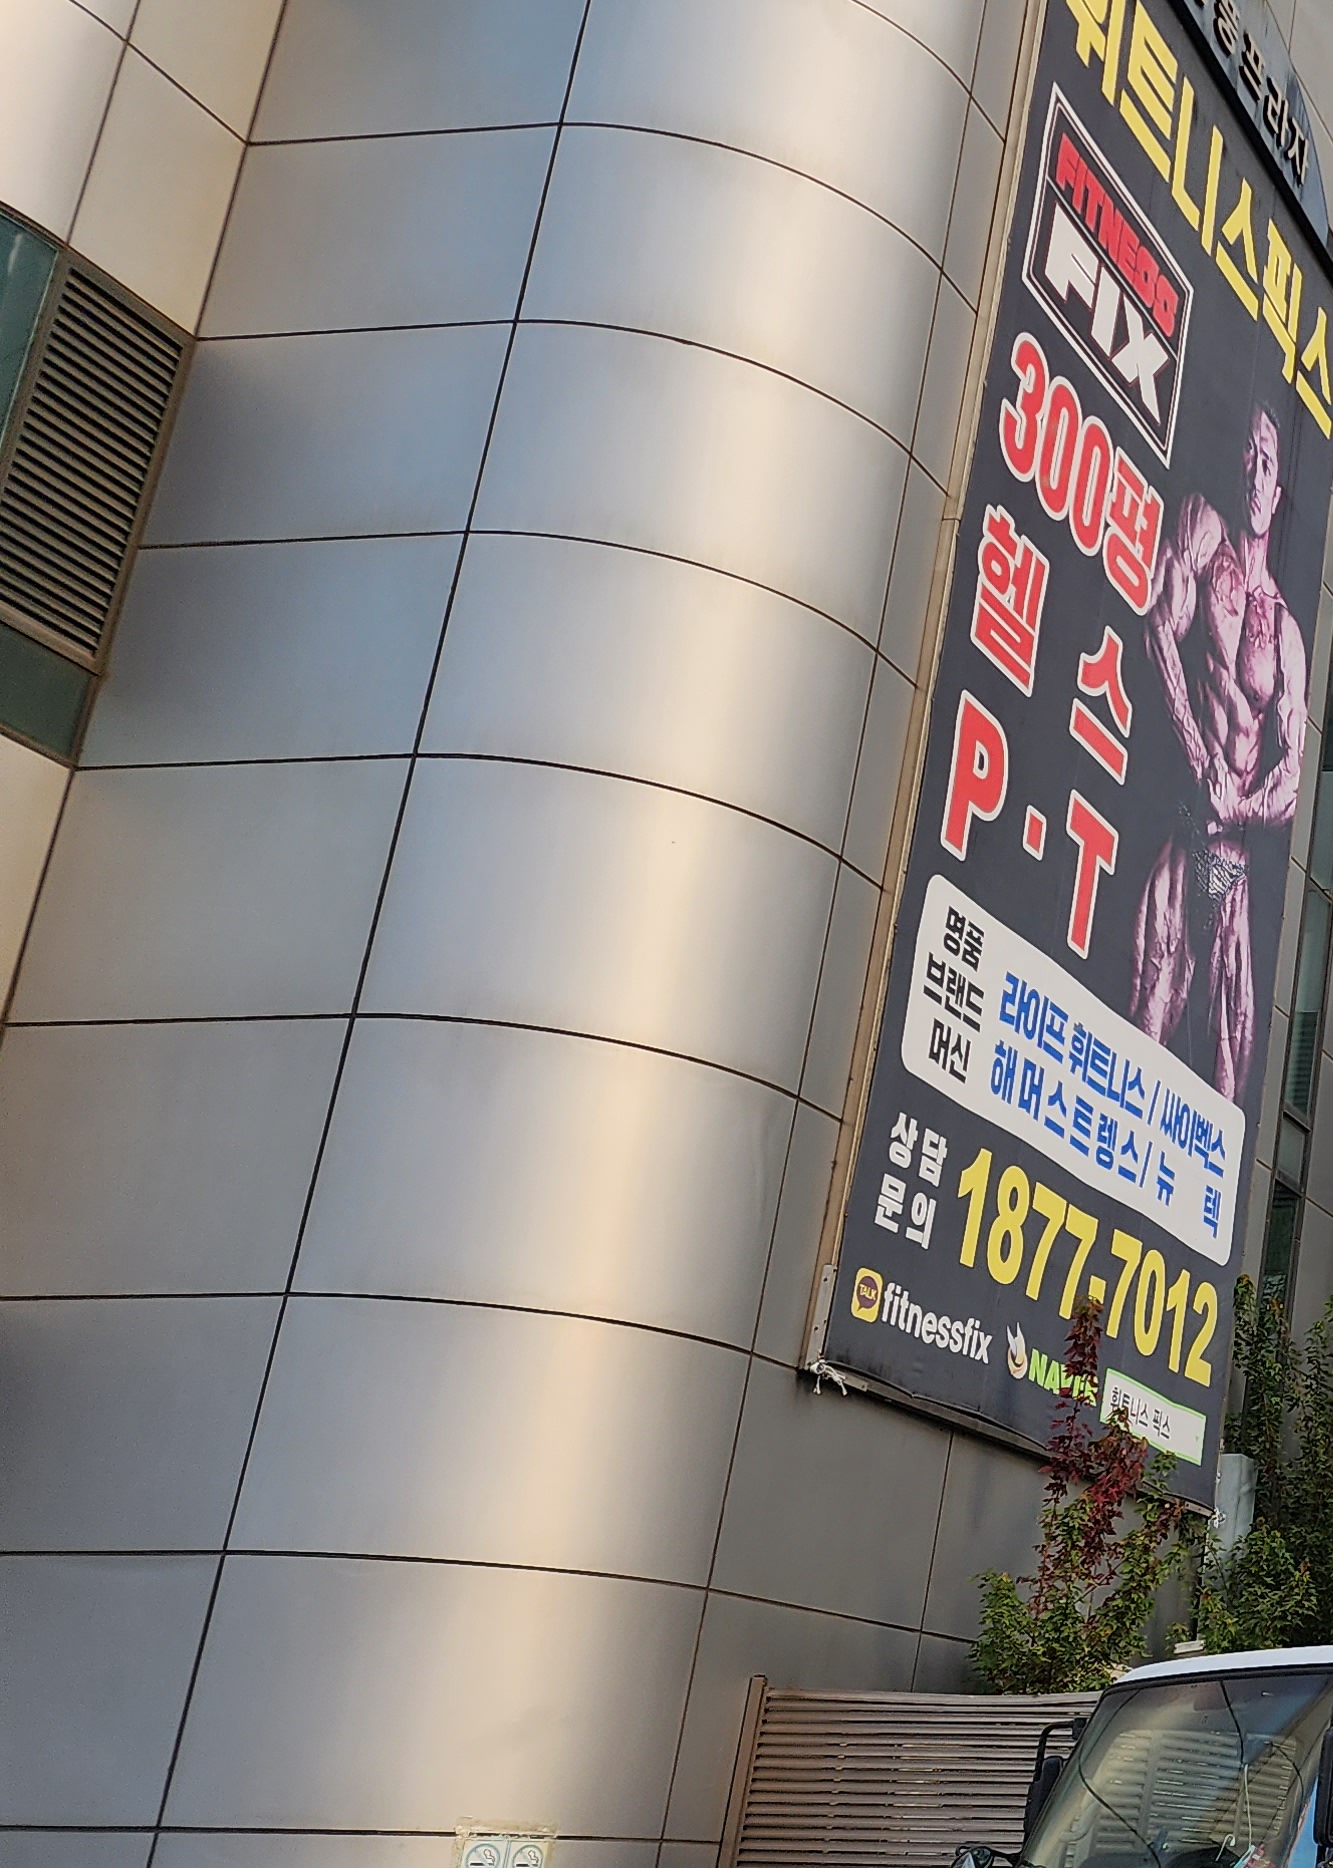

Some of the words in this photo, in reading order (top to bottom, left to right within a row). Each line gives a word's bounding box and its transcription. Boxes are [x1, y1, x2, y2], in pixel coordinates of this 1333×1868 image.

[1055, 133, 1178, 337] FITNESS
[1044, 201, 1170, 426] FIX
[999, 331, 1163, 615] 300평
[943, 905, 985, 972] 명품
[923, 952, 985, 1032] 브랜드
[928, 1018, 971, 1084] 머신
[1000, 971, 1069, 1063] 라이프
[1069, 1022, 1146, 1120] 휘트니스
[889, 1111, 948, 1188] 상담
[874, 1174, 936, 1250] 문의
[859, 1284, 877, 1301] TALK
[957, 1147, 1218, 1388] 1877-7012
[881, 1282, 993, 1364] fitnessfix
